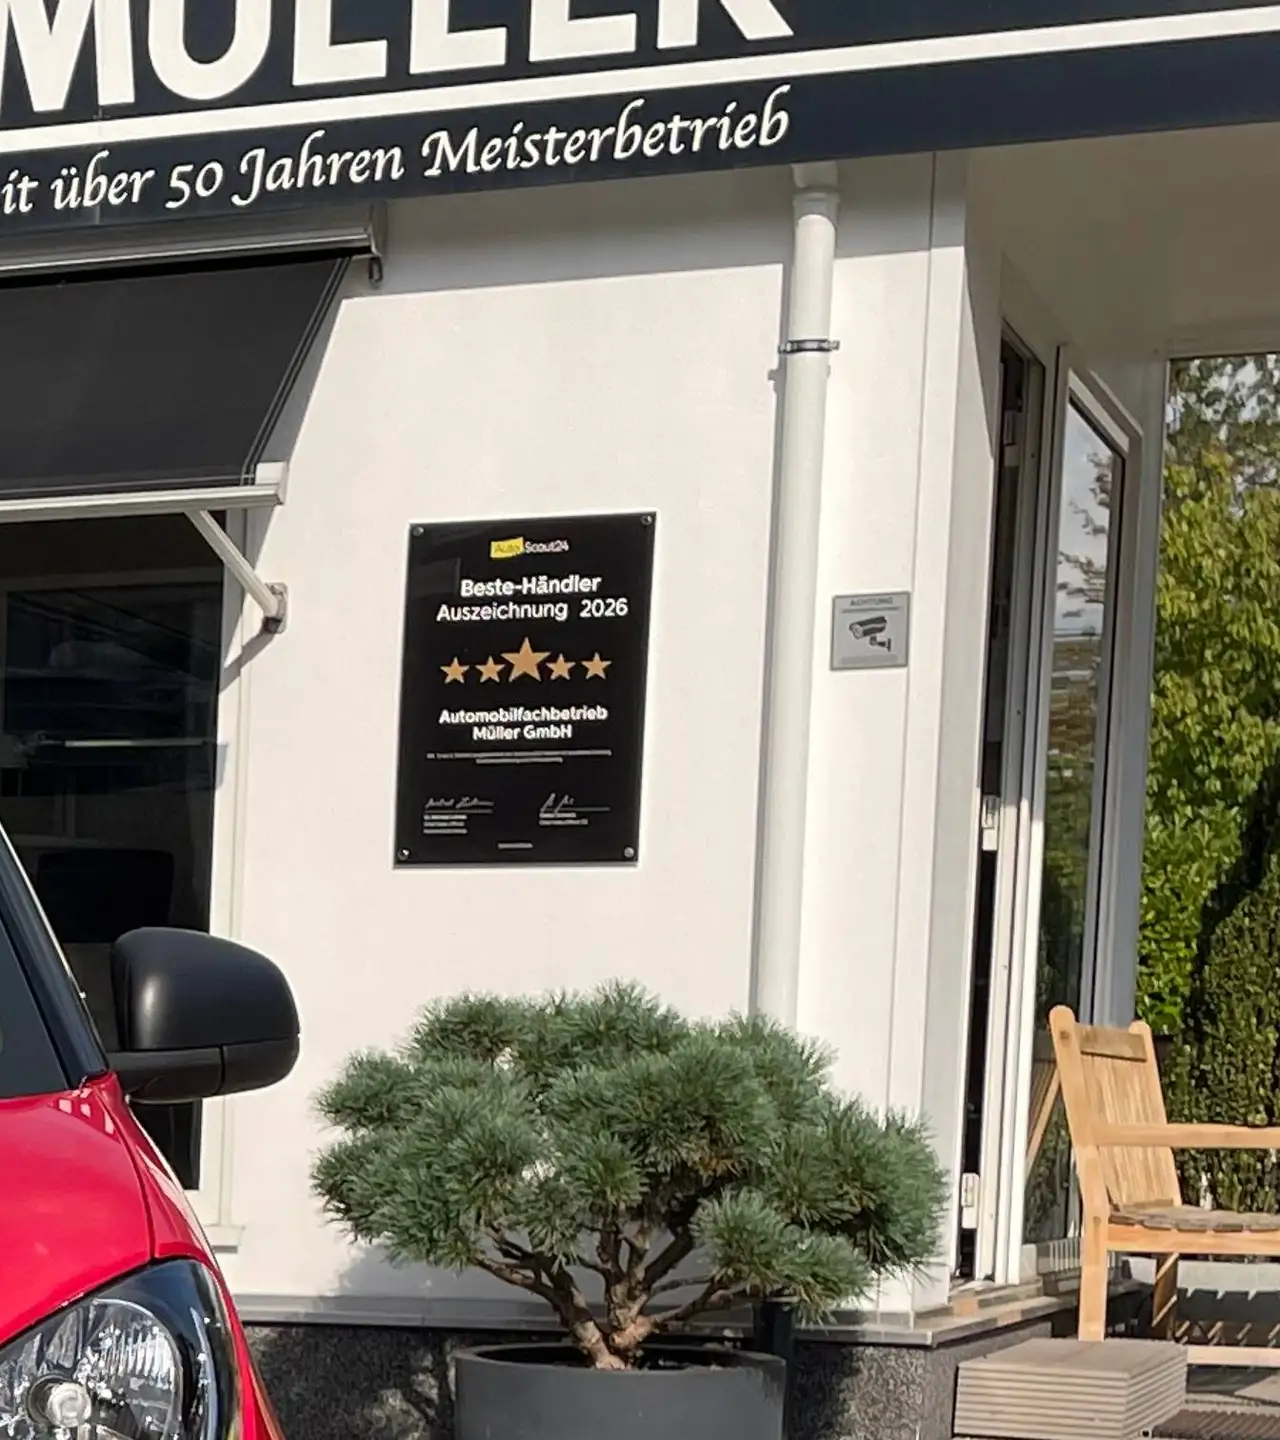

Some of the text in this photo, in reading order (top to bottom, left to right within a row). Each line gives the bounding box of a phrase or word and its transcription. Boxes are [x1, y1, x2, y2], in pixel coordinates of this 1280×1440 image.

[50, 149, 155, 209] über
[165, 162, 223, 209] 50
[231, 129, 405, 207] Jahren
[421, 84, 791, 178] Meisterbetrieb
[460, 573, 602, 597] Beste-Händler
[436, 597, 628, 622] Auszeichnung 2026
[439, 705, 608, 724] Automobilfachbetrieb
[472, 723, 573, 741] Müller GmbH
